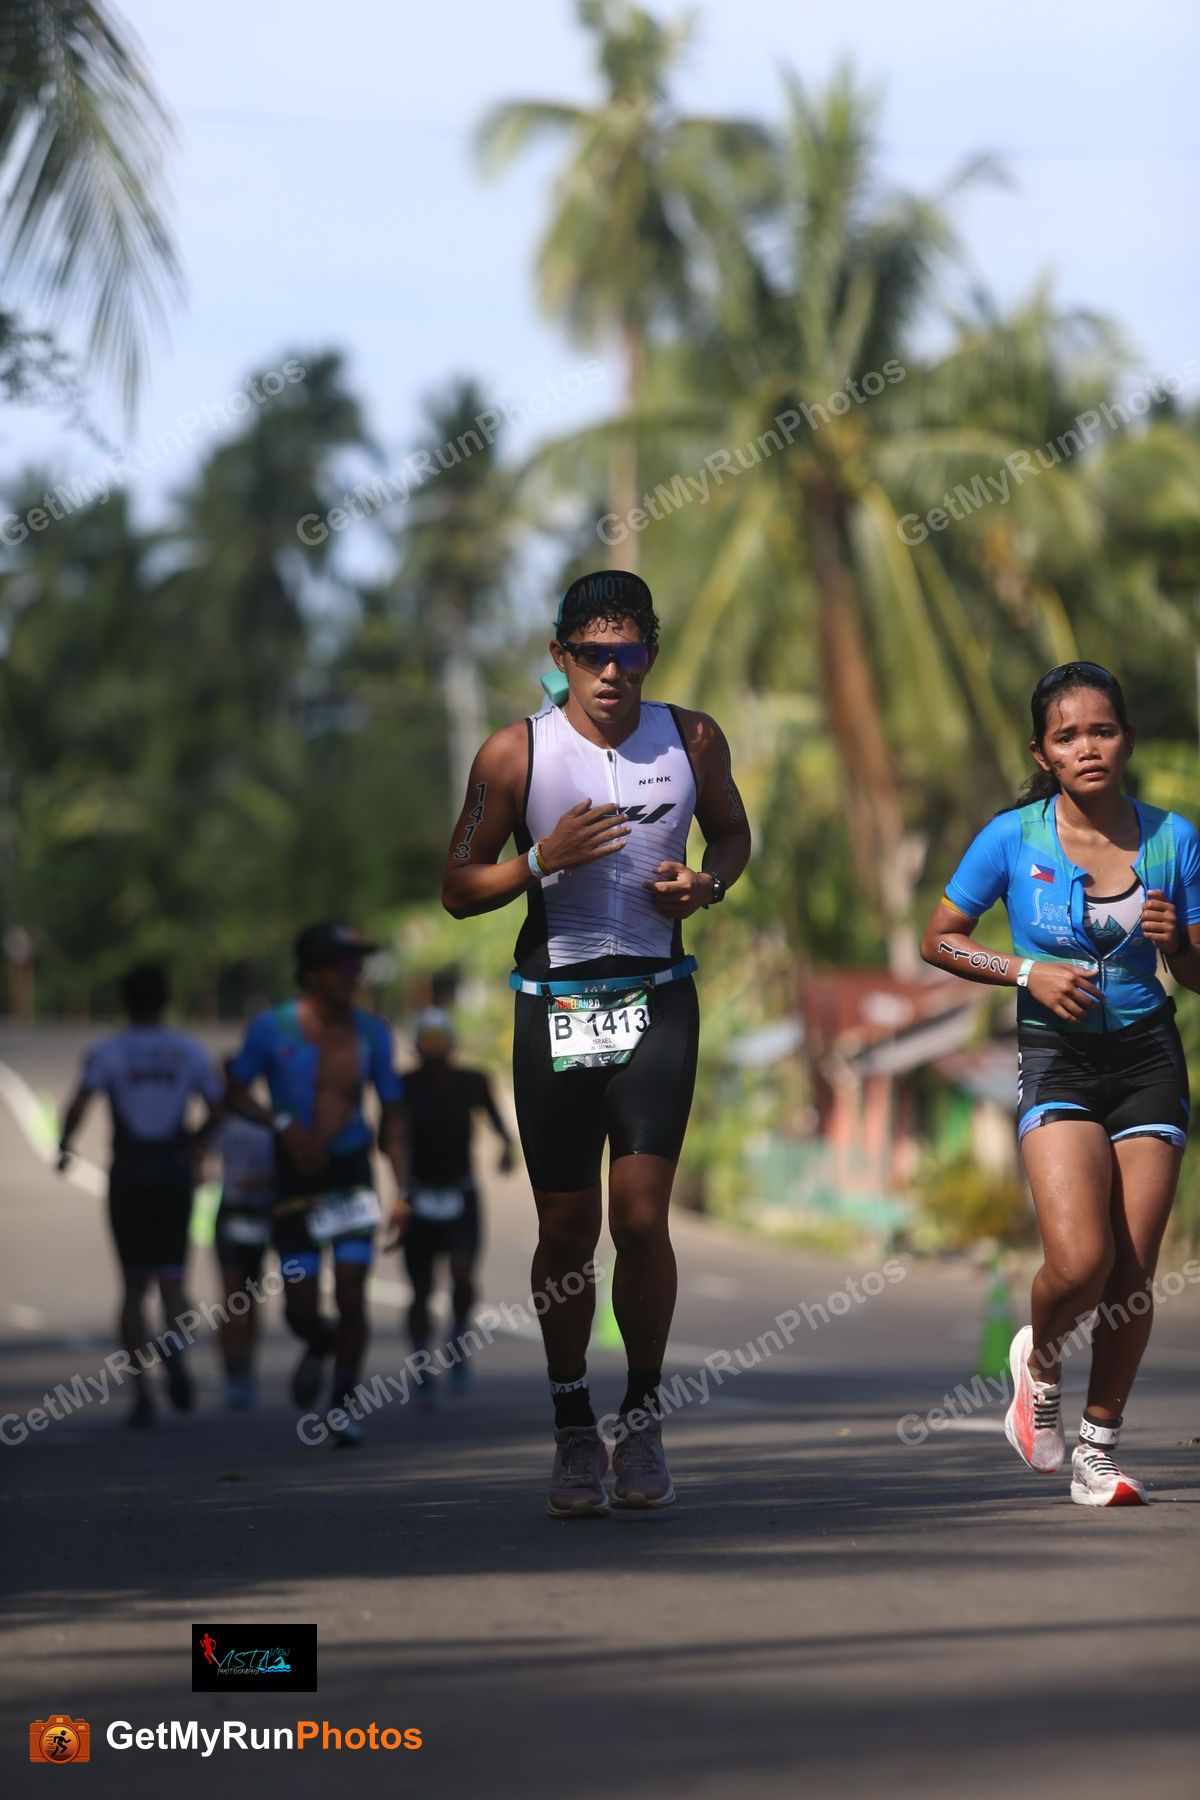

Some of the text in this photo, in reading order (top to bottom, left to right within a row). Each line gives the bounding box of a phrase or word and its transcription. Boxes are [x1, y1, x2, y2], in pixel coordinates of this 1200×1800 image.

[638, 775, 672, 786] NENK
[453, 781, 487, 861] 1413
[937, 940, 1011, 976] 1192
[553, 1007, 648, 1041] B 1413
